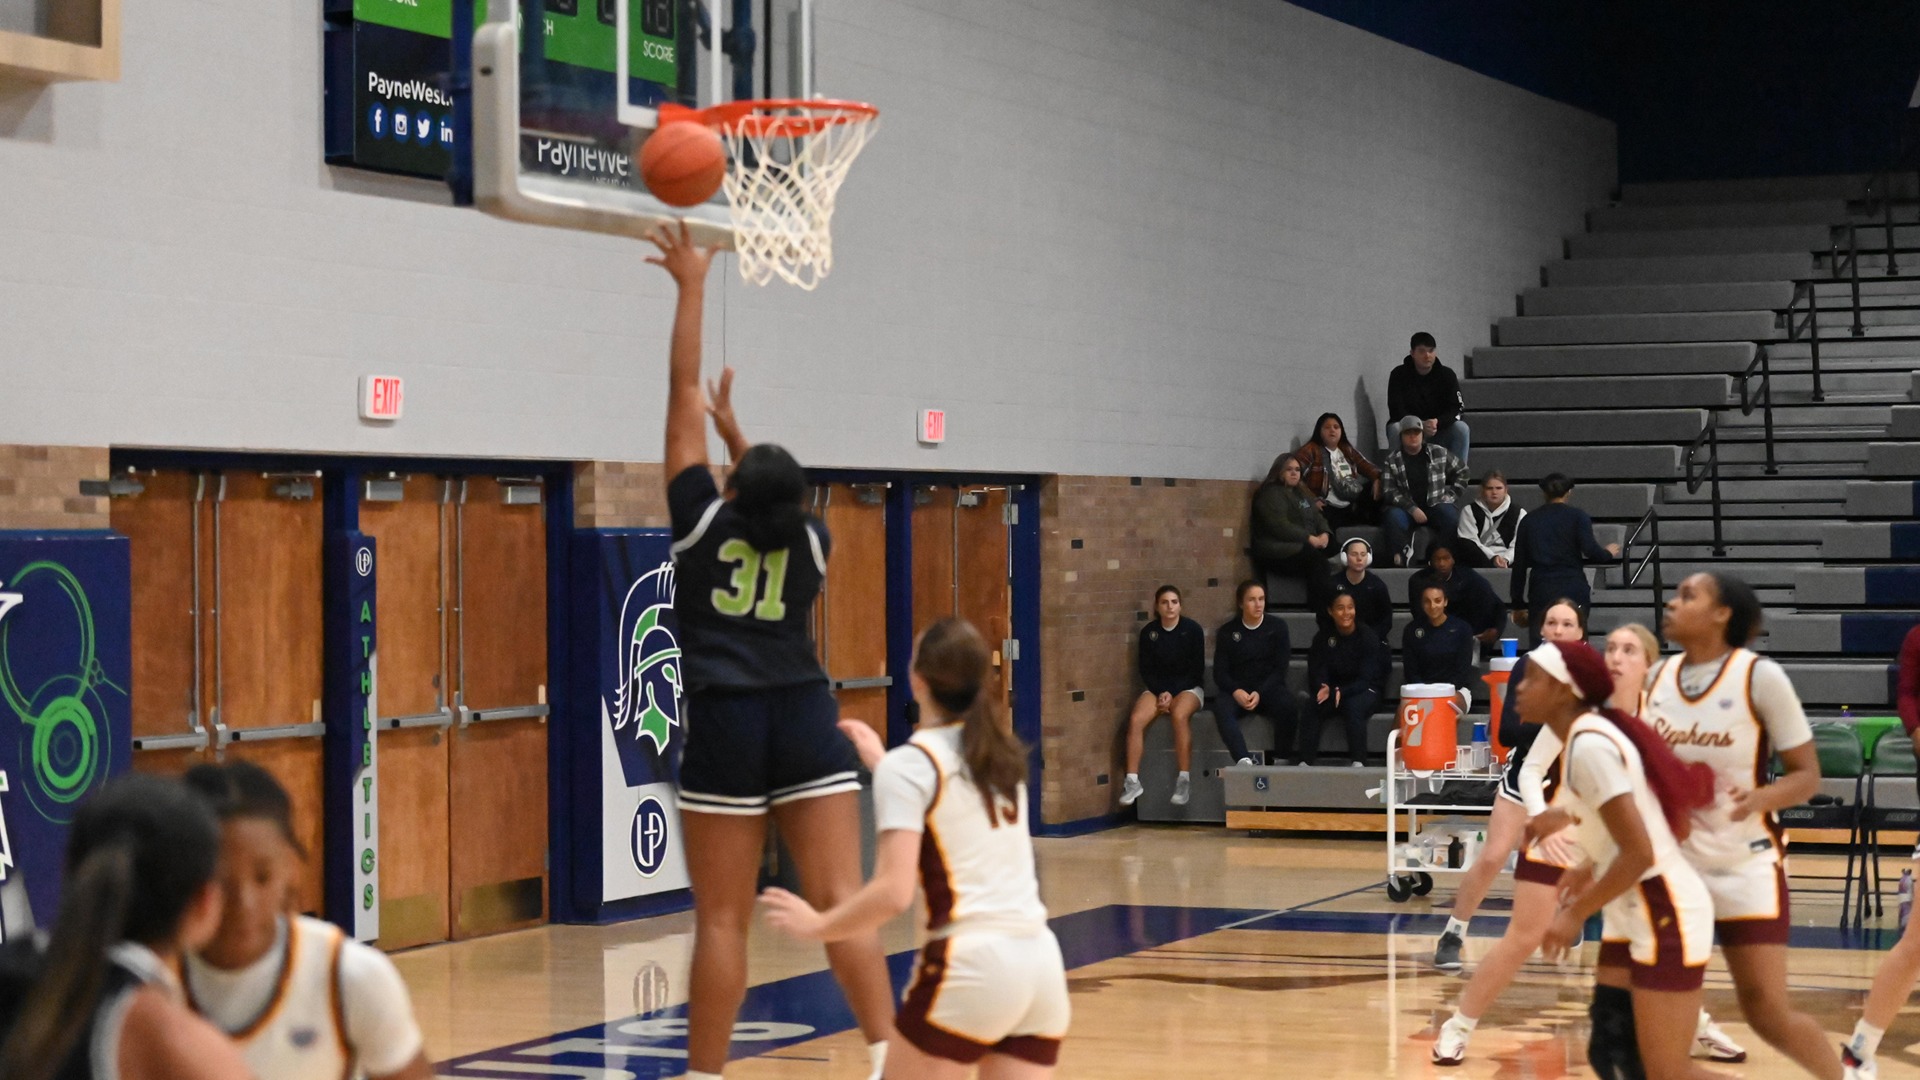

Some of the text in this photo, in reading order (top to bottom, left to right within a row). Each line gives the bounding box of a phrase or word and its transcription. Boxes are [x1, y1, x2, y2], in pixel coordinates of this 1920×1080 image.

[643, 40, 674, 63] SCORE
[373, 378, 400, 415] EXIT
[928, 411, 944, 439] EXIT
[710, 537, 789, 621] 31
[1404, 704, 1419, 726] G
[360, 600, 375, 911] ATHLETICS
